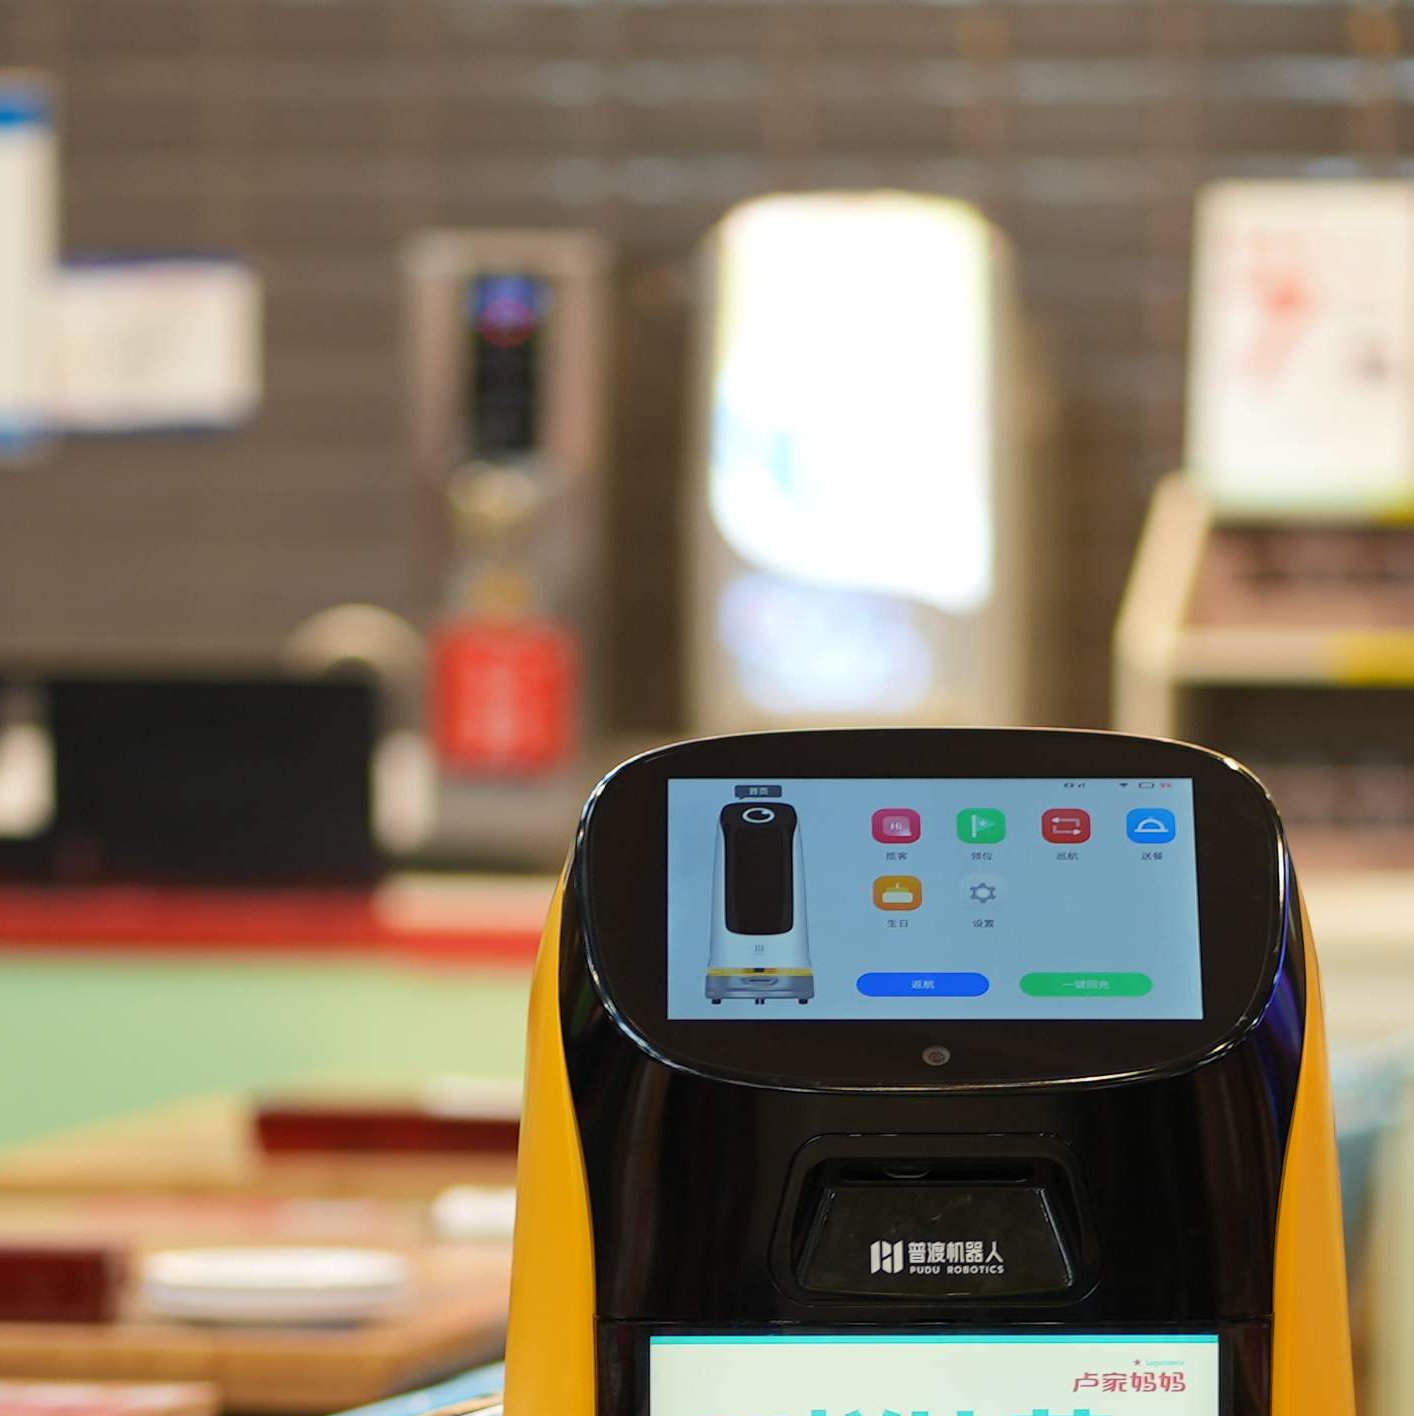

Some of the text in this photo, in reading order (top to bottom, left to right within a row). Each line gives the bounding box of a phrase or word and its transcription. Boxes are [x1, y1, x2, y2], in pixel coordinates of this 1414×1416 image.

[907, 1240, 1004, 1264] 普渡机器人
[909, 1264, 1005, 1275] PUDU ROBOTICS
[1072, 1371, 1187, 1393] 卢家妈妈
